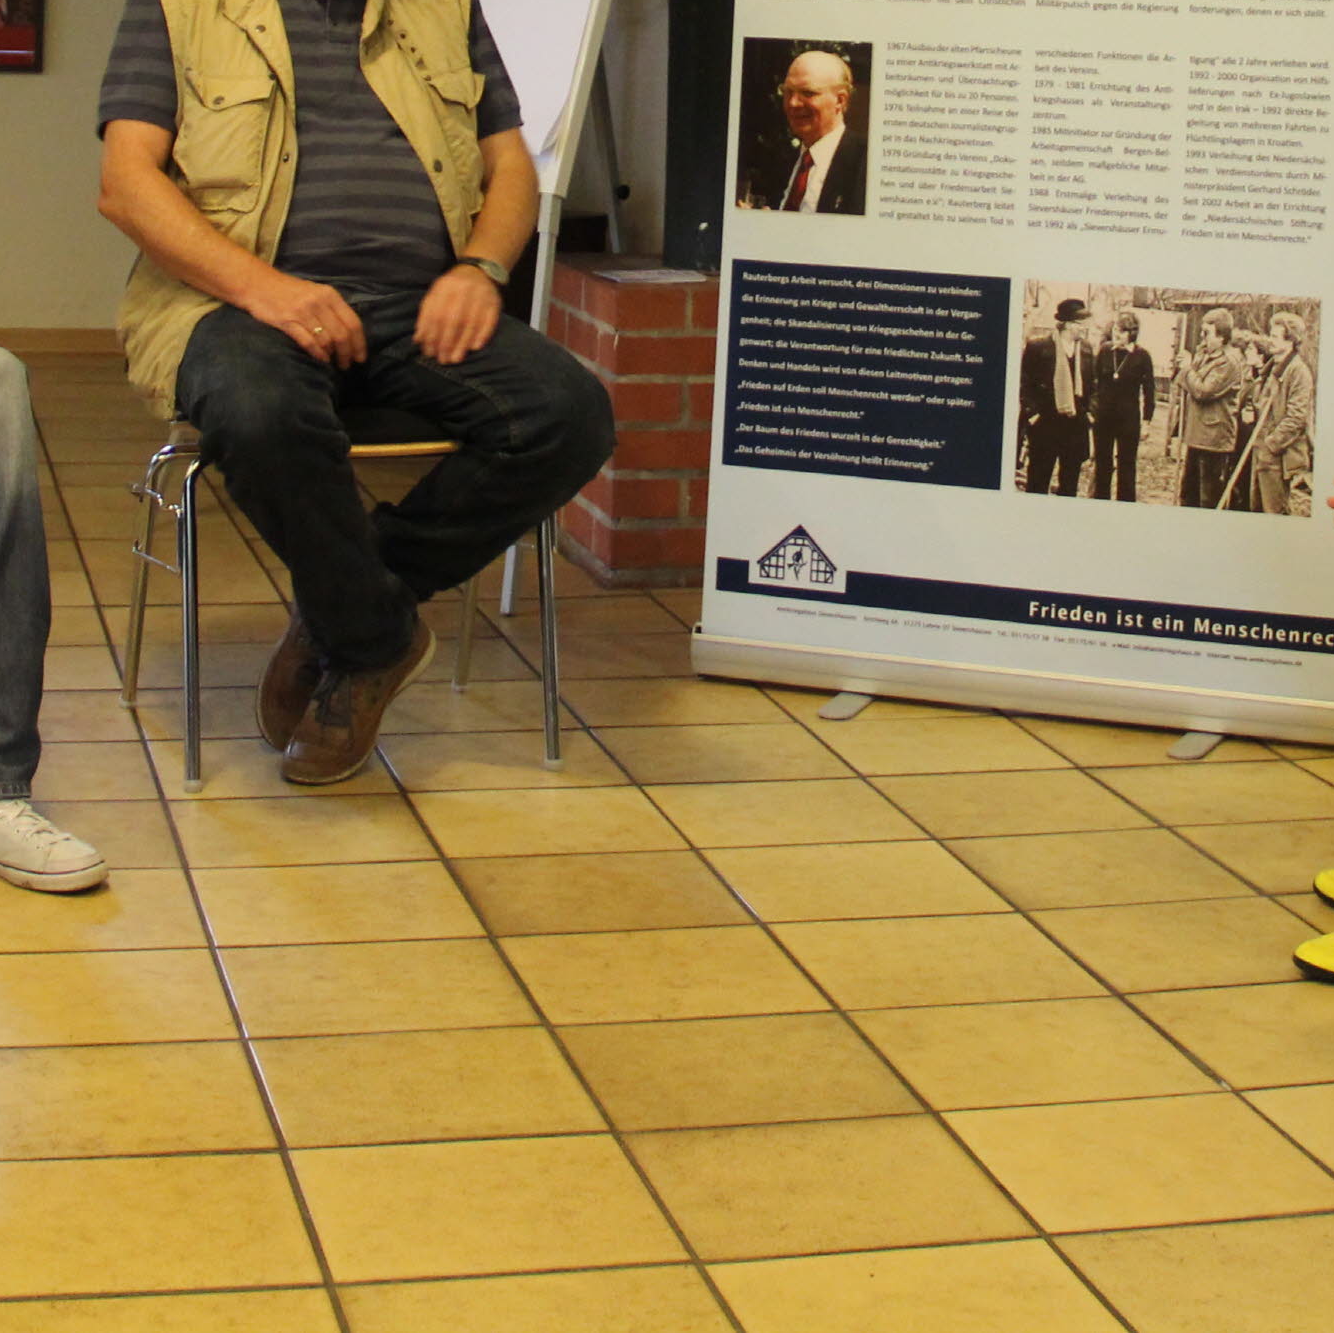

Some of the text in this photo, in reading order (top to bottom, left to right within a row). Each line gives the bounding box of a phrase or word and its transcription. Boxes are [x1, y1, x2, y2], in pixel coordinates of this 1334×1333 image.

[1029, 600, 1107, 624] Frieden
[1117, 609, 1144, 628] ist
[1152, 612, 1184, 632] ein
